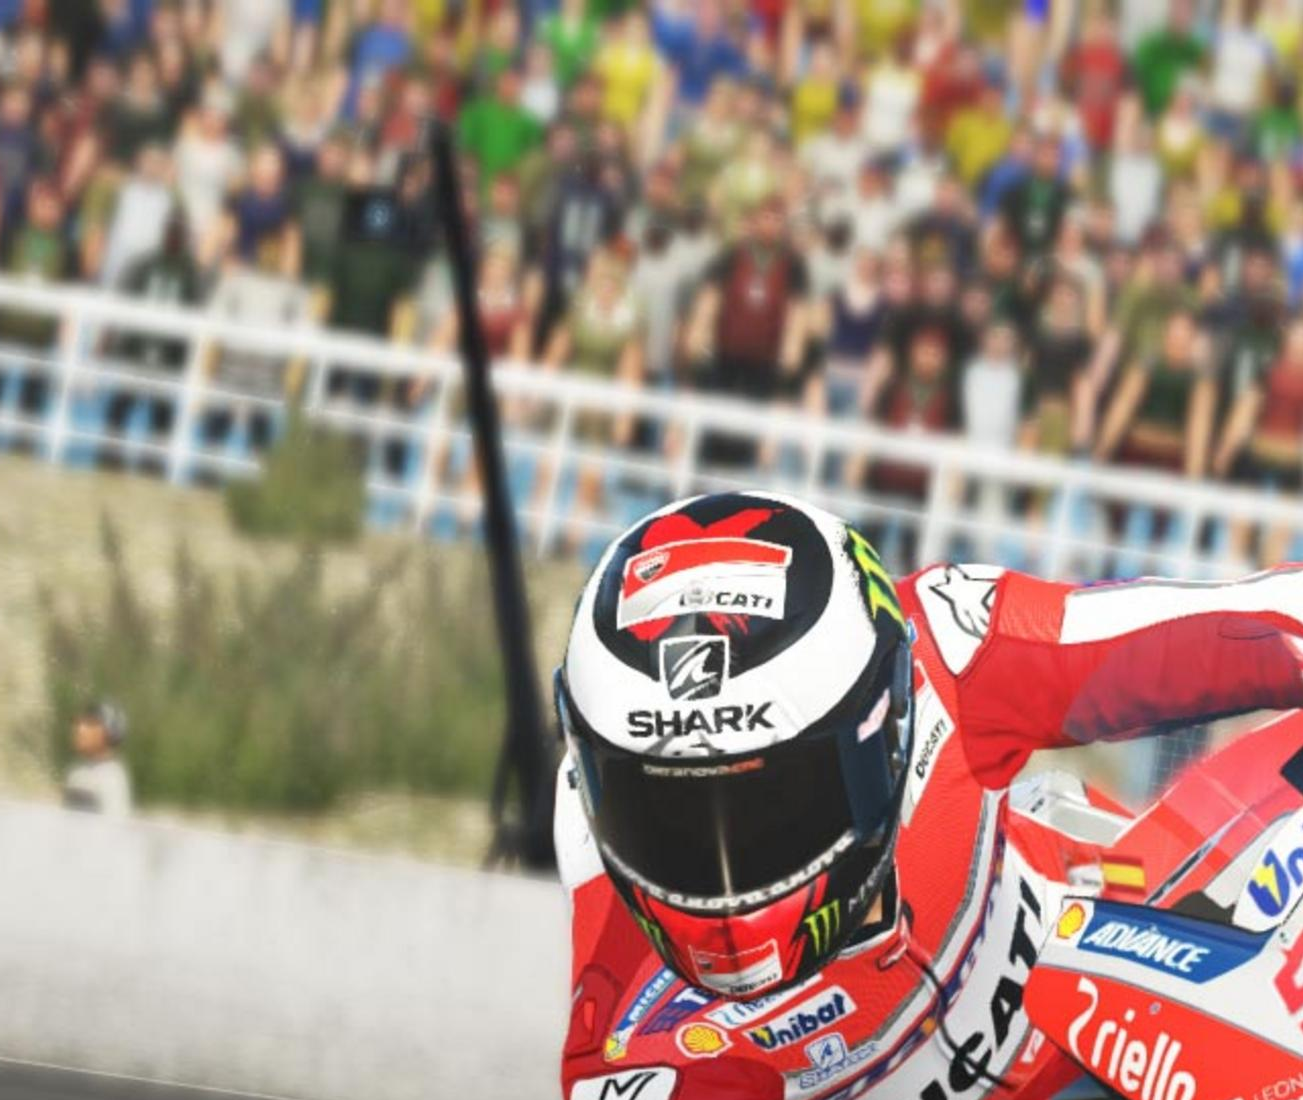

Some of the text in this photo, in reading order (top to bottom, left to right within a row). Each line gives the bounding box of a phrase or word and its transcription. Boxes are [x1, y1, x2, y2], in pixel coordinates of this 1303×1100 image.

[678, 591, 773, 609] CATI
[627, 702, 776, 737] SHARK
[1085, 920, 1210, 972] ADVANCE
[748, 993, 845, 1049] Unibat
